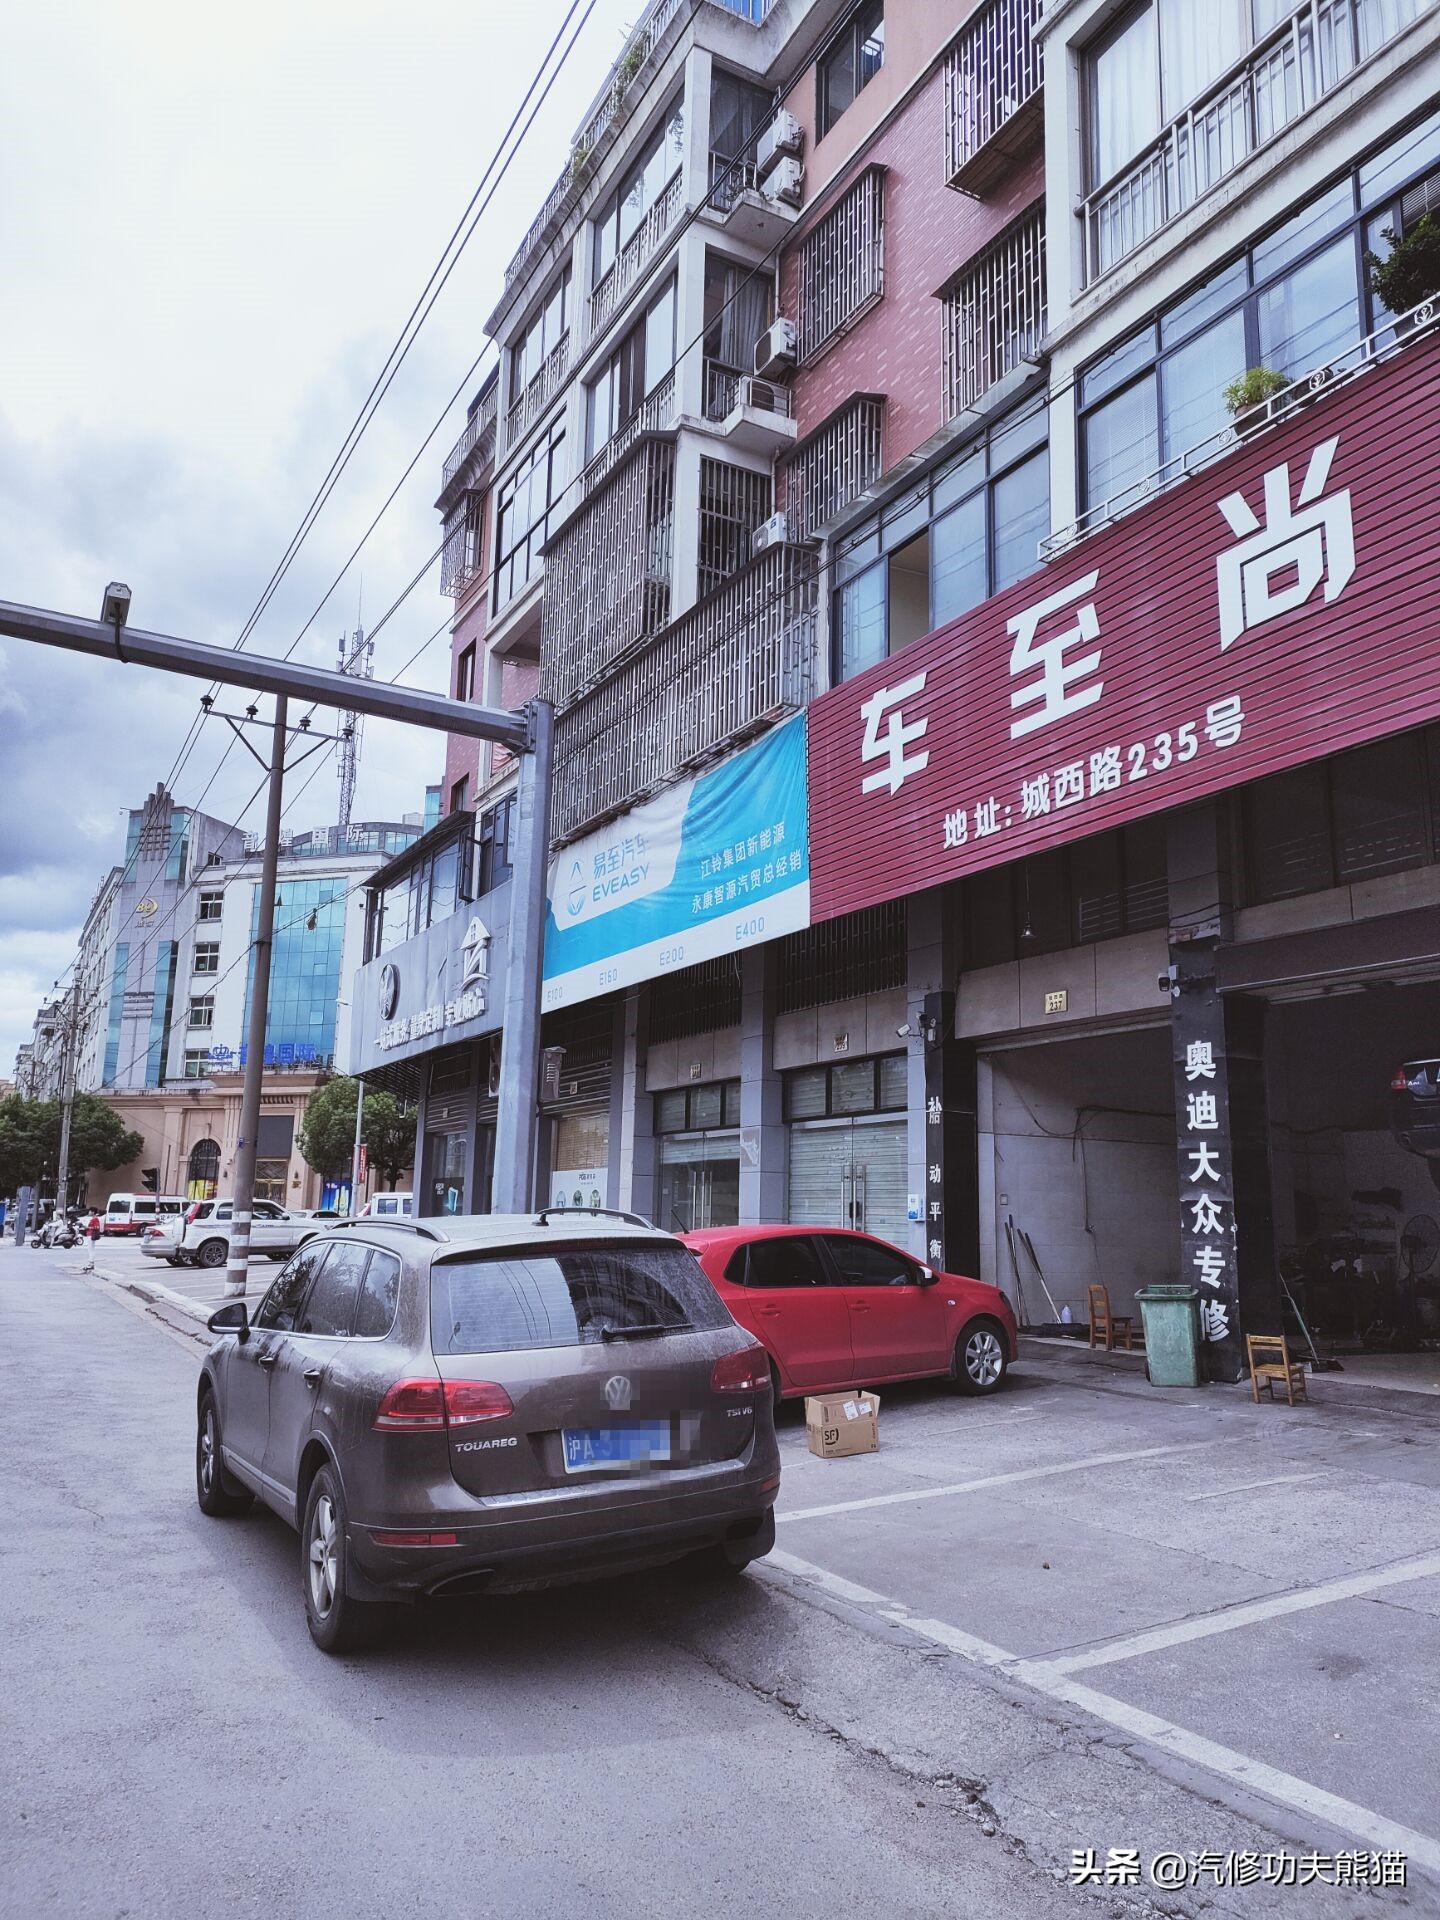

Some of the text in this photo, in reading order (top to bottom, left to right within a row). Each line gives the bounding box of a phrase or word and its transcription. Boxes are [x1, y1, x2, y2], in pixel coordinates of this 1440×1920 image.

[860, 436, 1356, 796] 车至尚
[593, 832, 651, 880] 易至汽车
[700, 821, 785, 880] 江铃集团新能源
[592, 862, 650, 902] EVEASY
[692, 849, 802, 914] 永康智源汽贸总经销
[736, 916, 765, 941] E400
[659, 946, 684, 966] E200
[1050, 1001, 1063, 1011] 237
[1185, 1040, 1230, 1342] 奥迪大众专修
[455, 1437, 518, 1453] TOUAREG
